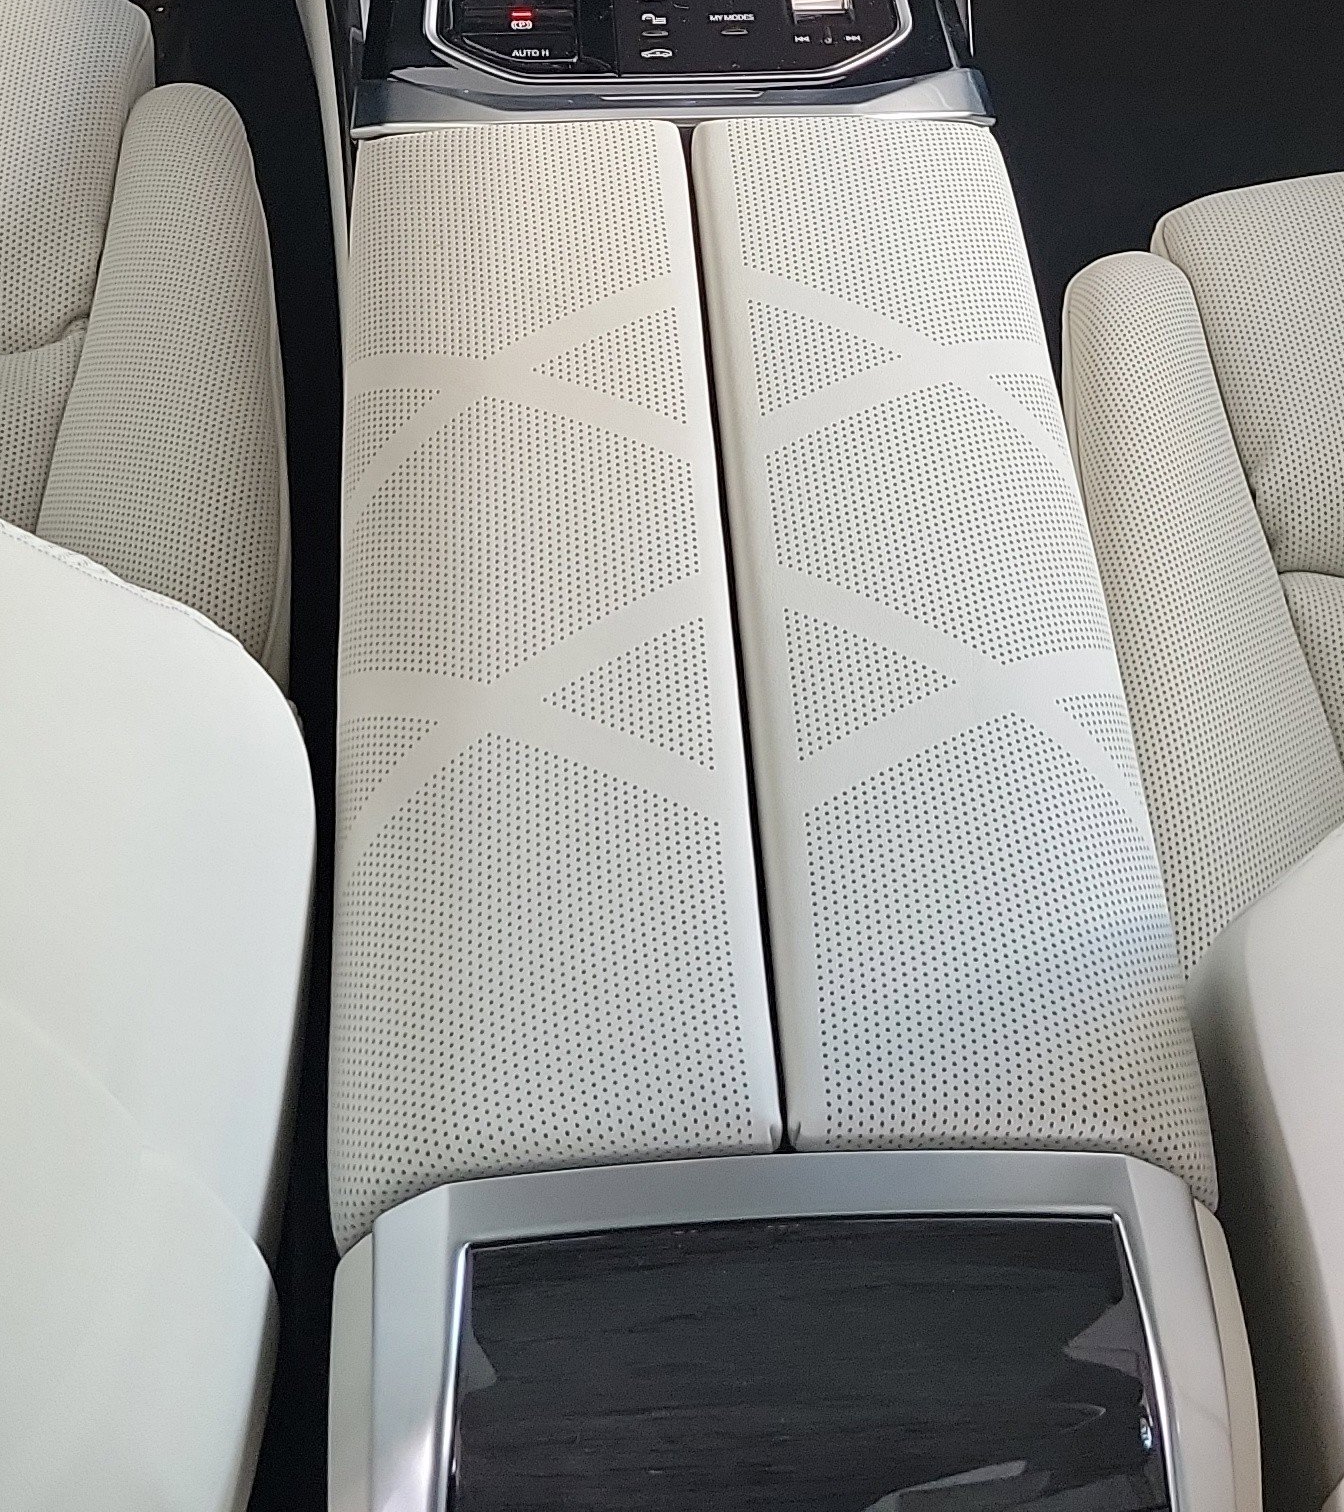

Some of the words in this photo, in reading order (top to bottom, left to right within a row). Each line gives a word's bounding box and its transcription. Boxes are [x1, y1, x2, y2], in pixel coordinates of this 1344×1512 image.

[709, 13, 724, 21] MY
[724, 13, 755, 21] MODES
[512, 49, 540, 57] AUTO
[541, 49, 550, 57] H
